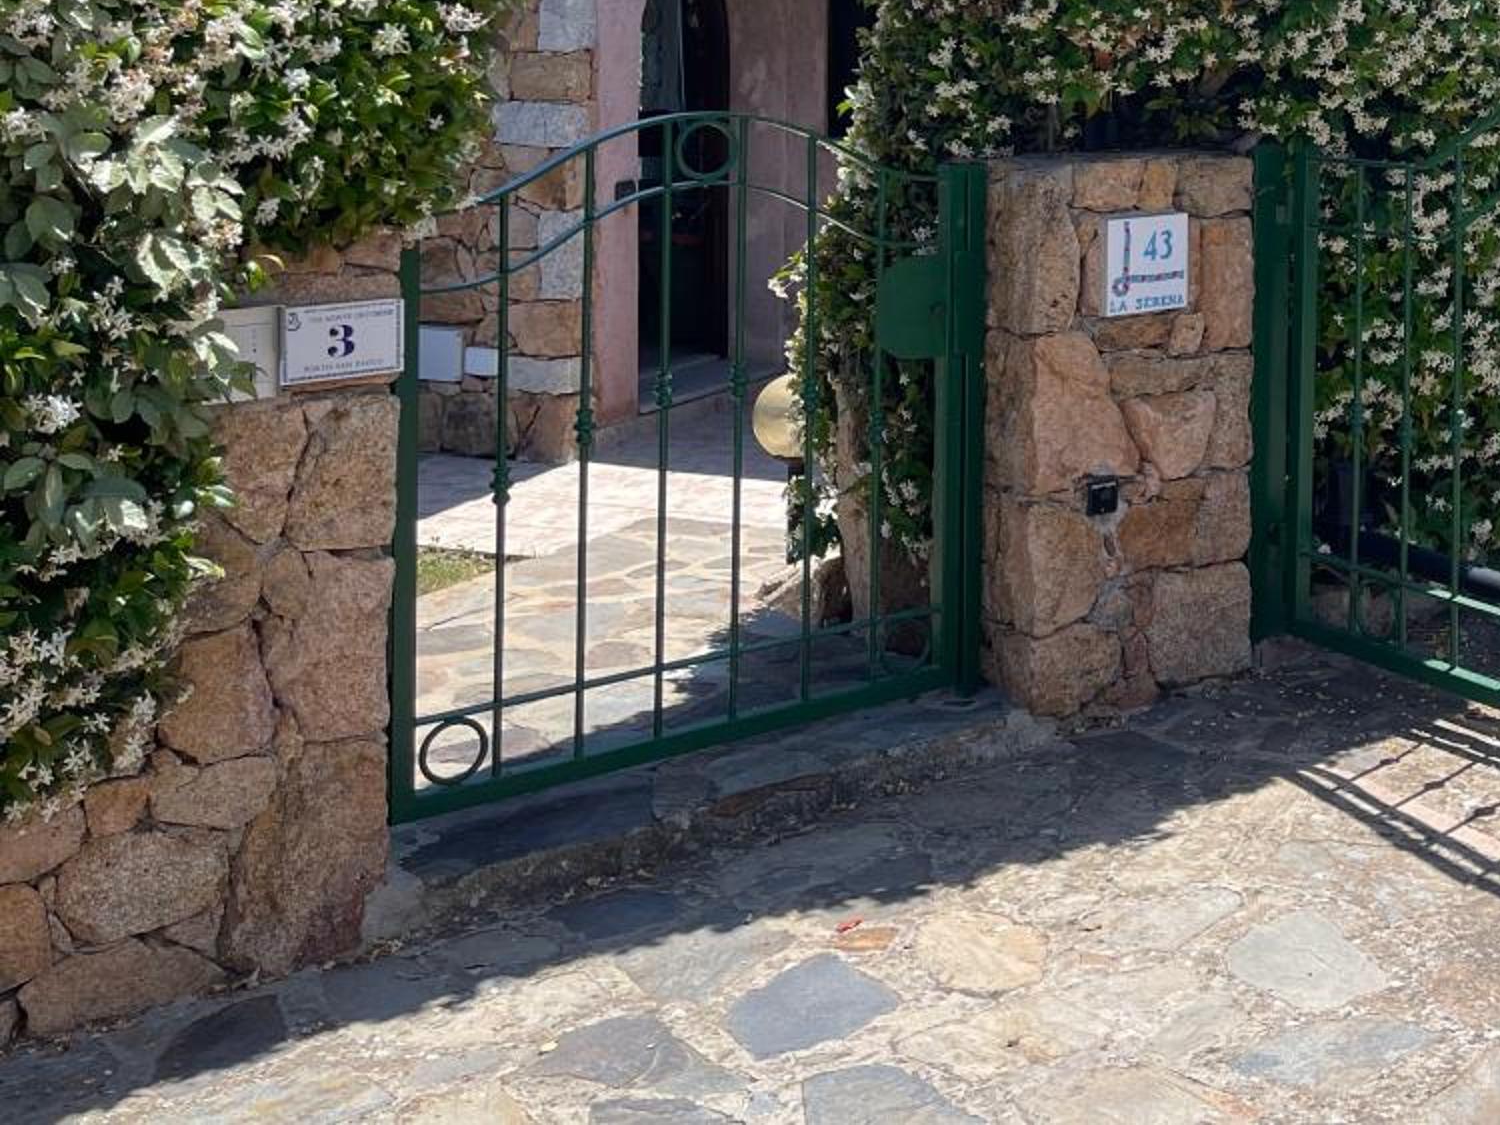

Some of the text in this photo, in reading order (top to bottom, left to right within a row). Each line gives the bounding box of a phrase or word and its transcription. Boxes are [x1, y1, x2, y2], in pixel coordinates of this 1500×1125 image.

[1142, 229, 1173, 262] 43
[1109, 294, 1185, 314] LA SERENA
[327, 324, 355, 357] 3
